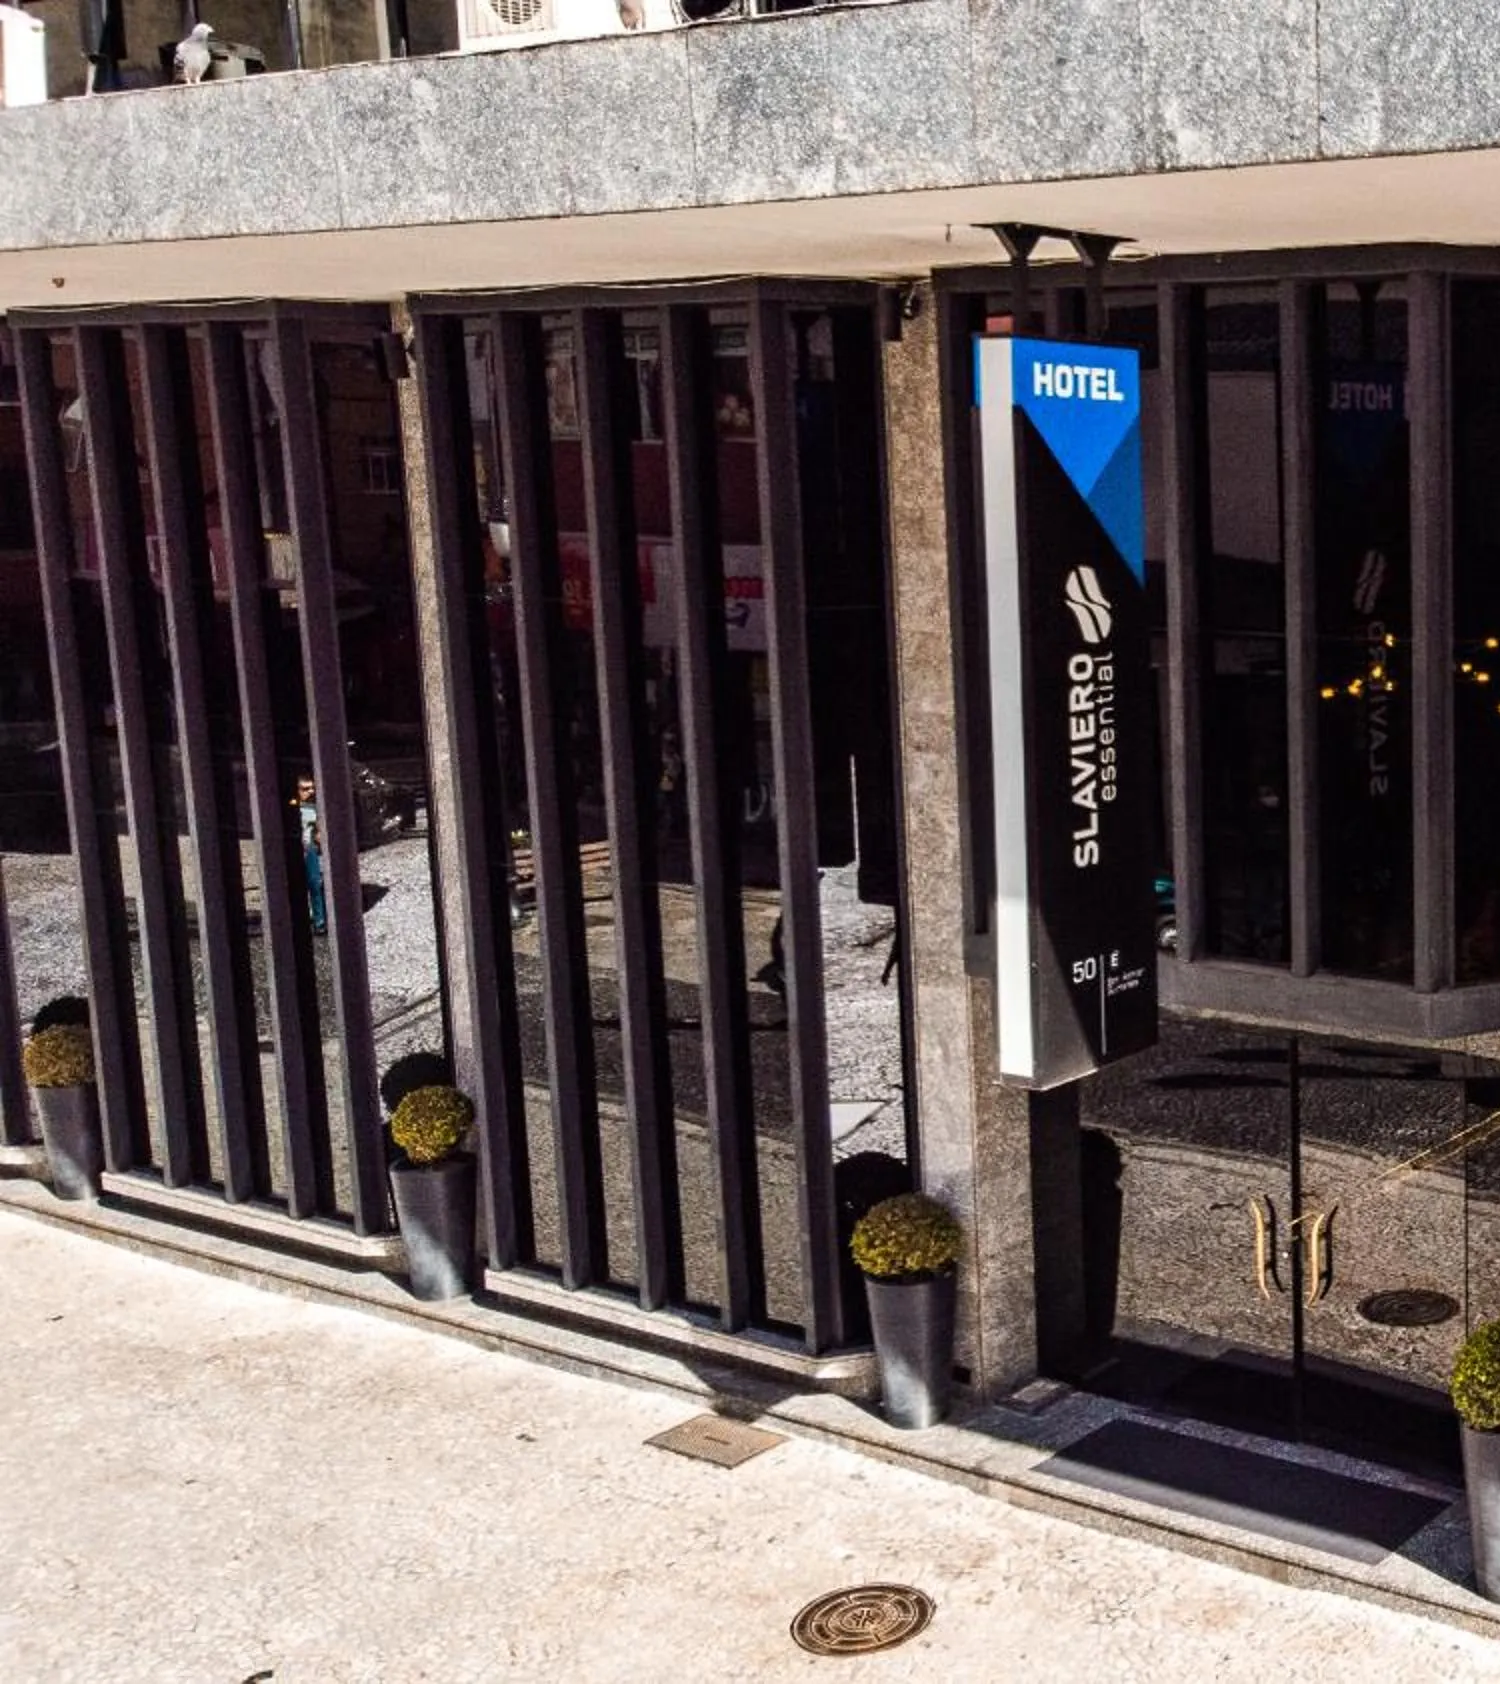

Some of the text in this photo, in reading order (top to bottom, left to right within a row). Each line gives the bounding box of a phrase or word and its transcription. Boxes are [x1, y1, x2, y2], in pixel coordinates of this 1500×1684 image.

[1033, 361, 1125, 401] HOTEL
[1068, 653, 1099, 868] SLAVIERO
[1094, 651, 1117, 801] essential
[1072, 957, 1097, 984] 50
